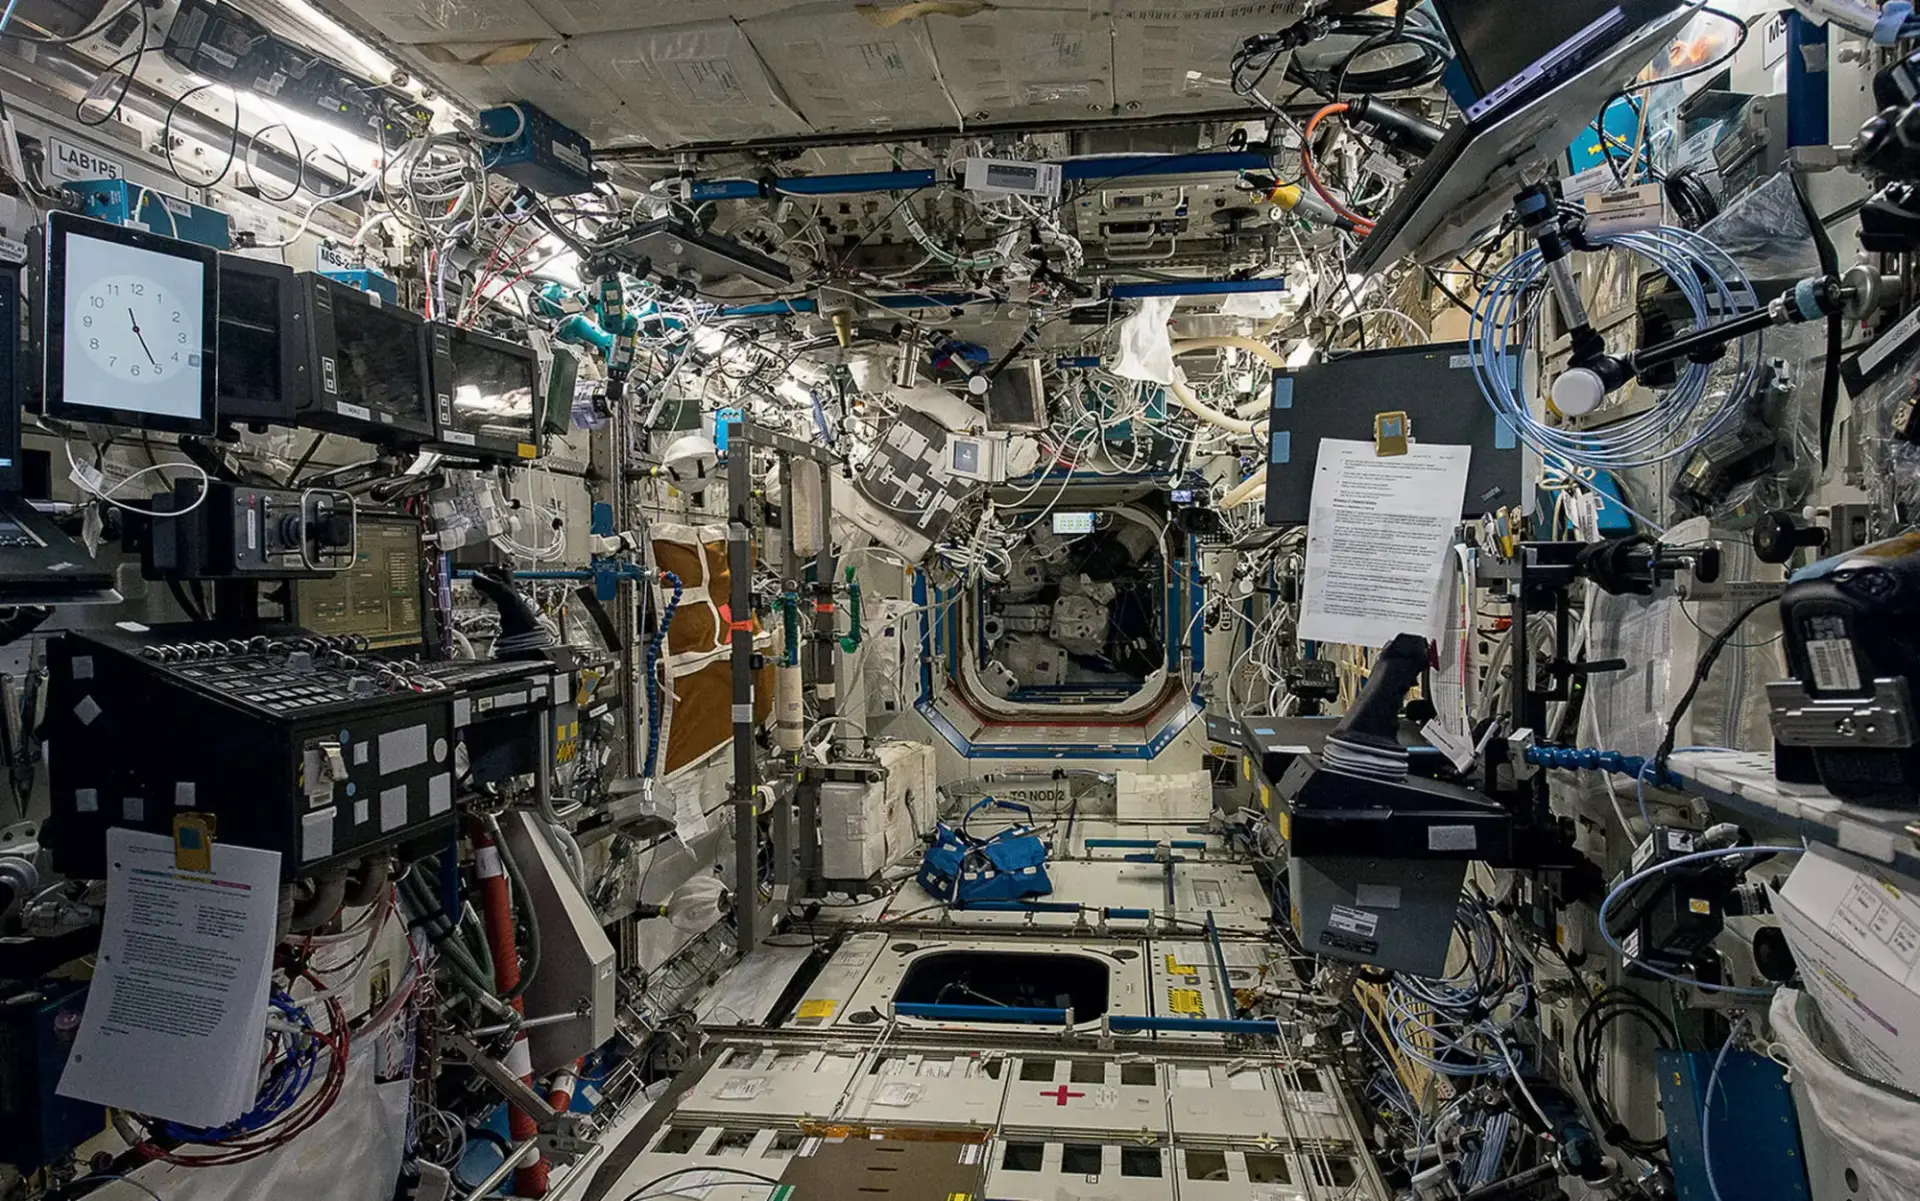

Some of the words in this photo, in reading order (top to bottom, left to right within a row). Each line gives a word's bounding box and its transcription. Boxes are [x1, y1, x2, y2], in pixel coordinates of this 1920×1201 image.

[58, 144, 117, 180] LAB1P5
[107, 283, 119, 296] 11
[130, 283, 144, 296] 12
[89, 295, 104, 308] 10
[157, 293, 162, 304] 1
[83, 315, 93, 328] 9
[171, 311, 181, 323] 2
[89, 338, 99, 350] 8
[178, 332, 187, 344] 3
[109, 356, 117, 367] 7
[171, 352, 179, 362] 4
[130, 365, 140, 377] 6
[153, 363, 163, 375] 5
